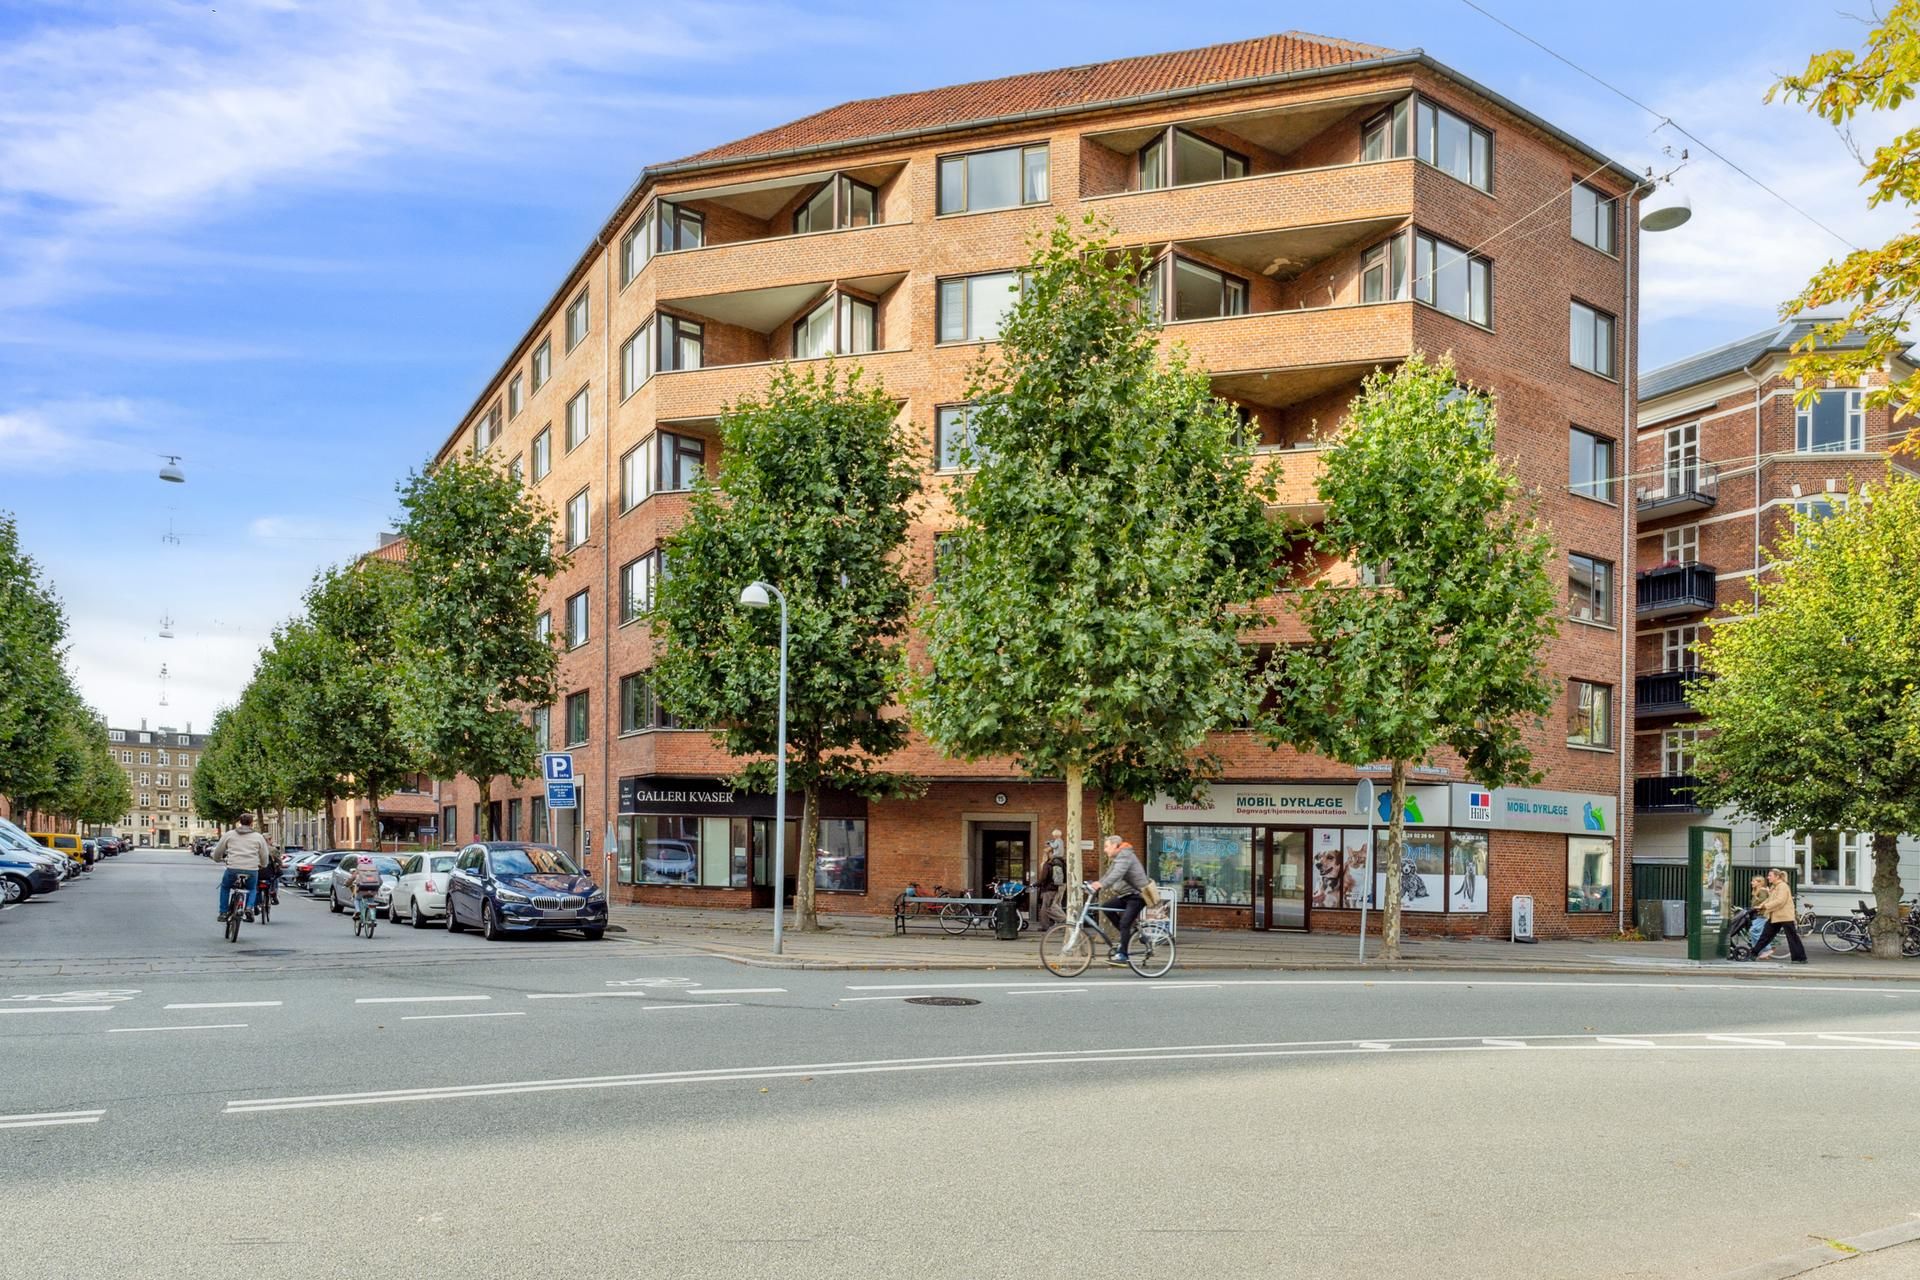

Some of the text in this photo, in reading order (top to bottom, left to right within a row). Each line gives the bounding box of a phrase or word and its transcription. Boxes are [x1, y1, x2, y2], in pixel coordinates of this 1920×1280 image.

[552, 757, 567, 778] P
[636, 790, 686, 802] GALLERI
[689, 791, 734, 803] KVASER
[1236, 797, 1343, 808] MOBIL DYRLÆGE
[1471, 807, 1490, 820] Hill's
[1507, 802, 1568, 816] MOBIL DYRLÆGE
